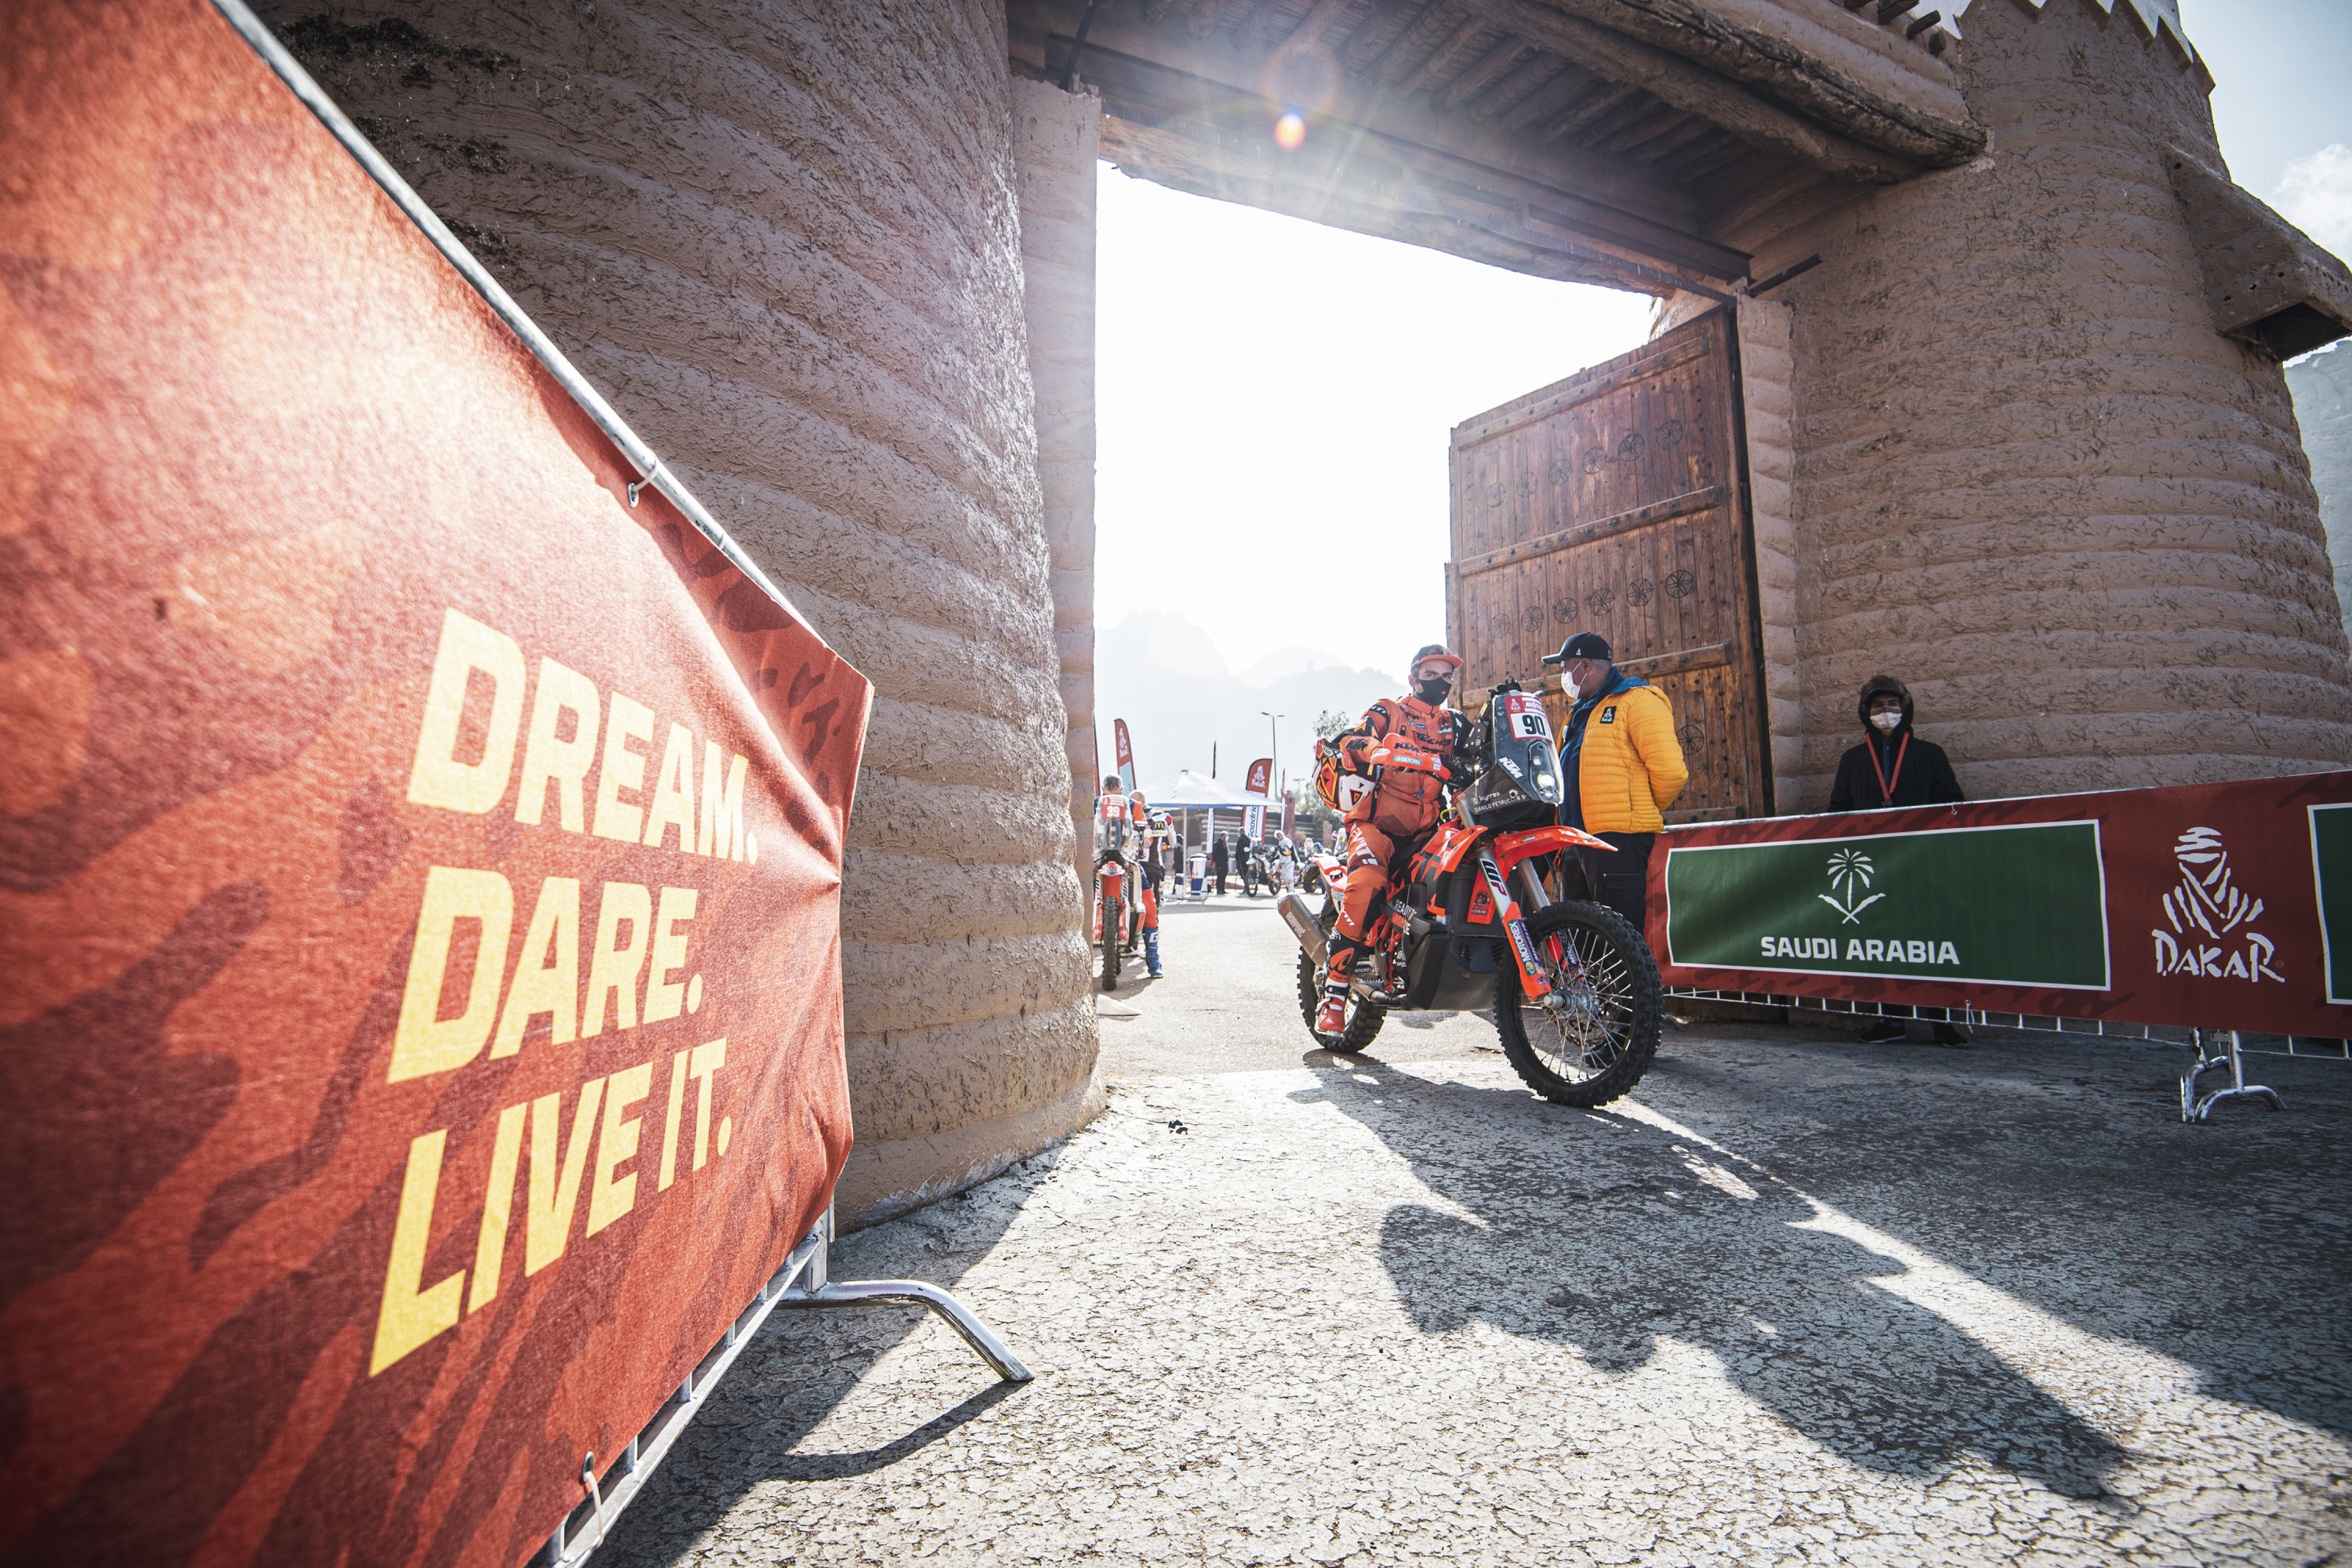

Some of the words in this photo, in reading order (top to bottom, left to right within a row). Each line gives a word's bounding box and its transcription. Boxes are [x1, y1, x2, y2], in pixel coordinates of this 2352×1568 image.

[407, 606, 758, 864] DREAM.
[1522, 714, 1546, 736] 90
[1394, 742, 1419, 753] KTM
[1401, 756, 1422, 765] MOTOREX
[1498, 757, 1523, 779] KTM
[1106, 805, 1120, 818] 39
[1474, 804, 1492, 813] DANILO
[1508, 920, 1530, 962] MOTOREX
[1761, 936, 1838, 960] SAUDI
[1846, 939, 1961, 965] ARABIA
[2151, 929, 2285, 982] DAKAR
[386, 866, 703, 1084] DARE.
[369, 1062, 653, 1377] LIVE
[658, 1037, 732, 1192] IT.
